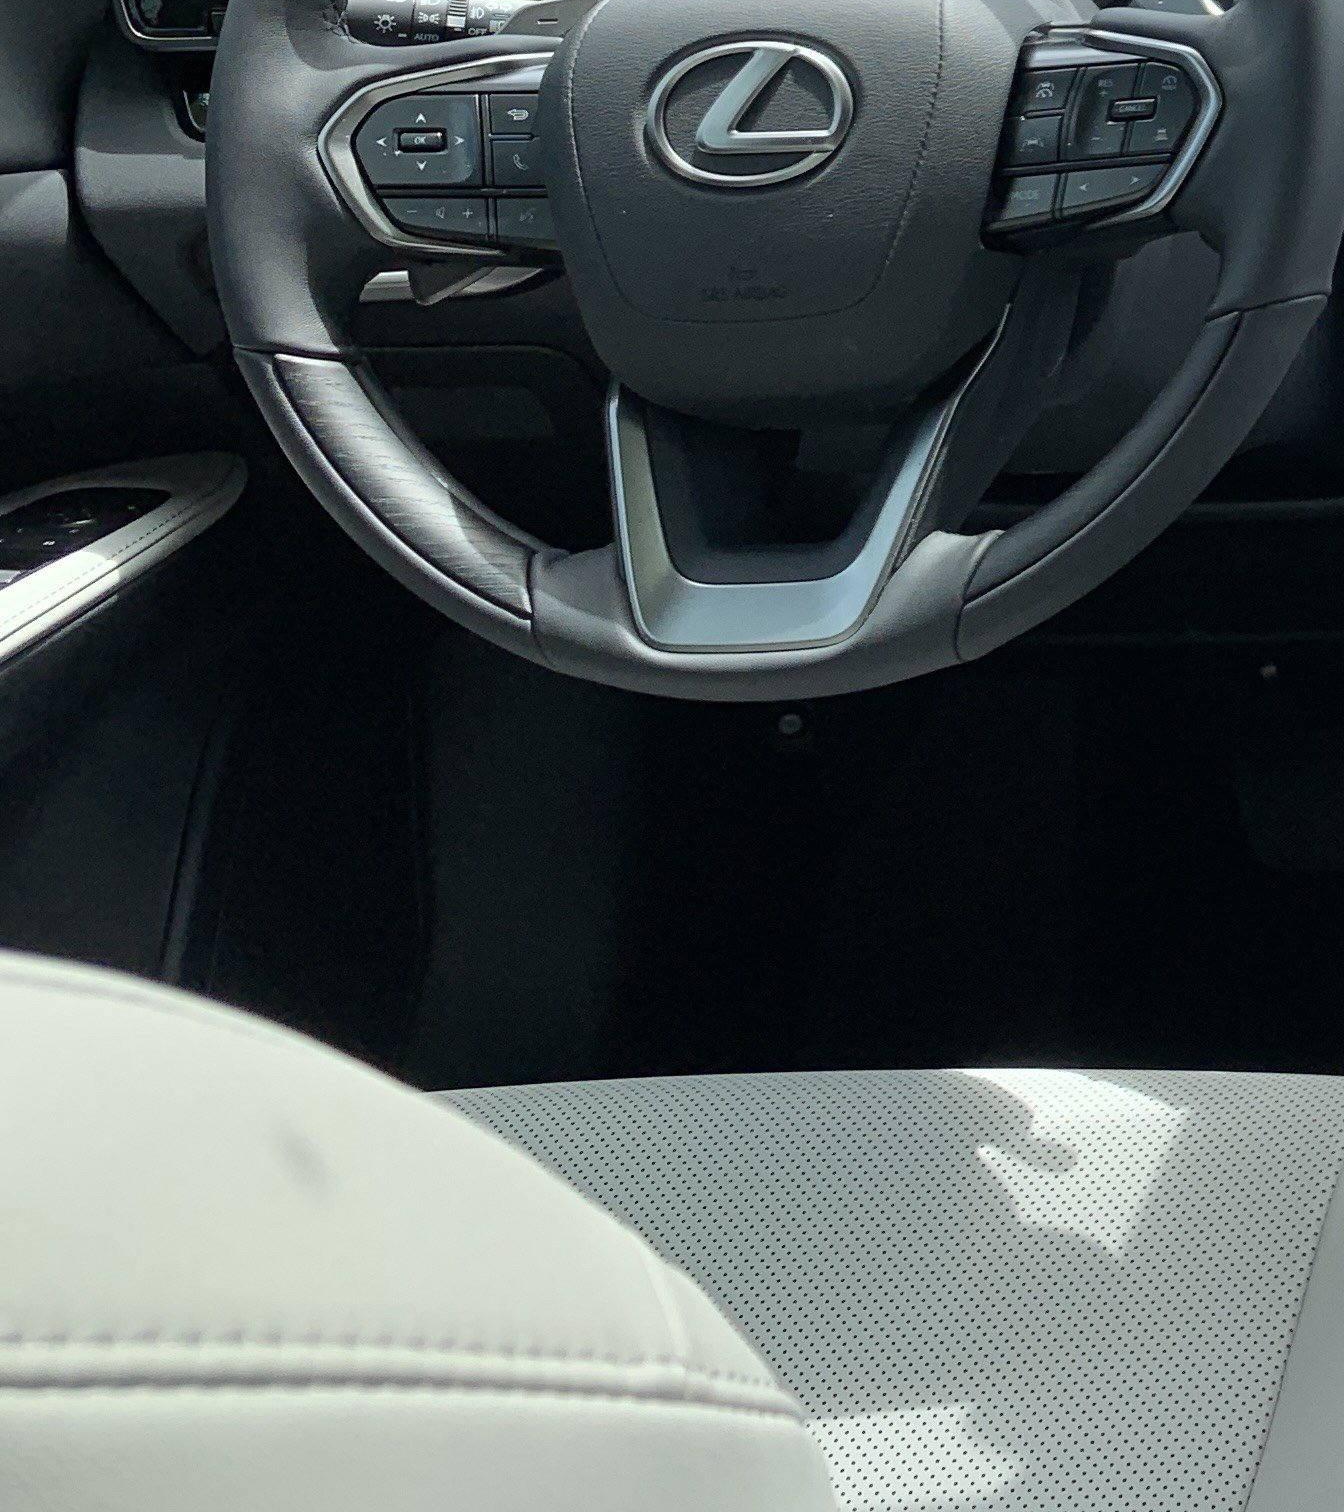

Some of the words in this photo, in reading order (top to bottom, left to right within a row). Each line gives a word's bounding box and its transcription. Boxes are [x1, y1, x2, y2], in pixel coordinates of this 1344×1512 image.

[468, 28, 488, 36] OFF
[413, 33, 440, 42] AUTO
[413, 135, 427, 145] OK
[1011, 189, 1039, 201] MODE
